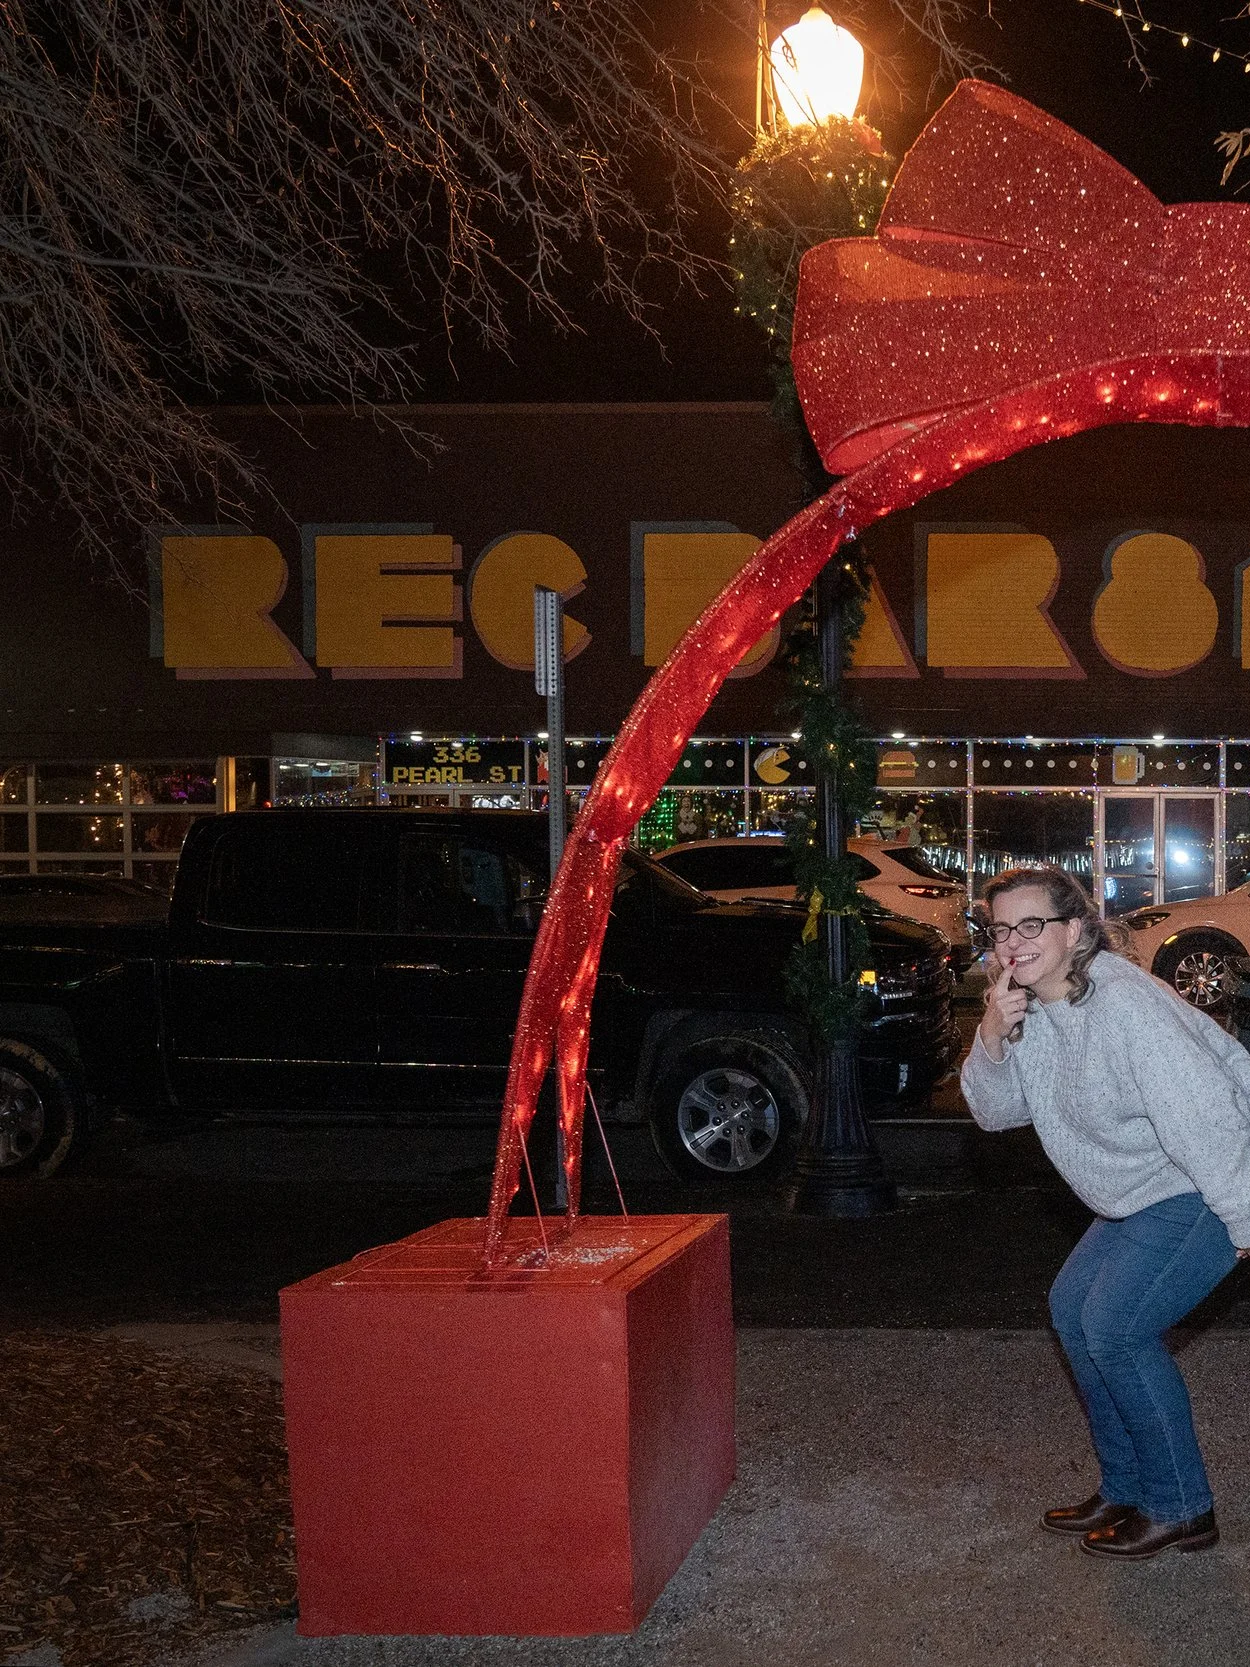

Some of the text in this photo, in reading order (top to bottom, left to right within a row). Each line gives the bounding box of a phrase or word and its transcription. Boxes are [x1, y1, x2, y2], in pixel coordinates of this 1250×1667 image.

[433, 746, 481, 763] 336
[393, 765, 522, 783] PEARL ST
